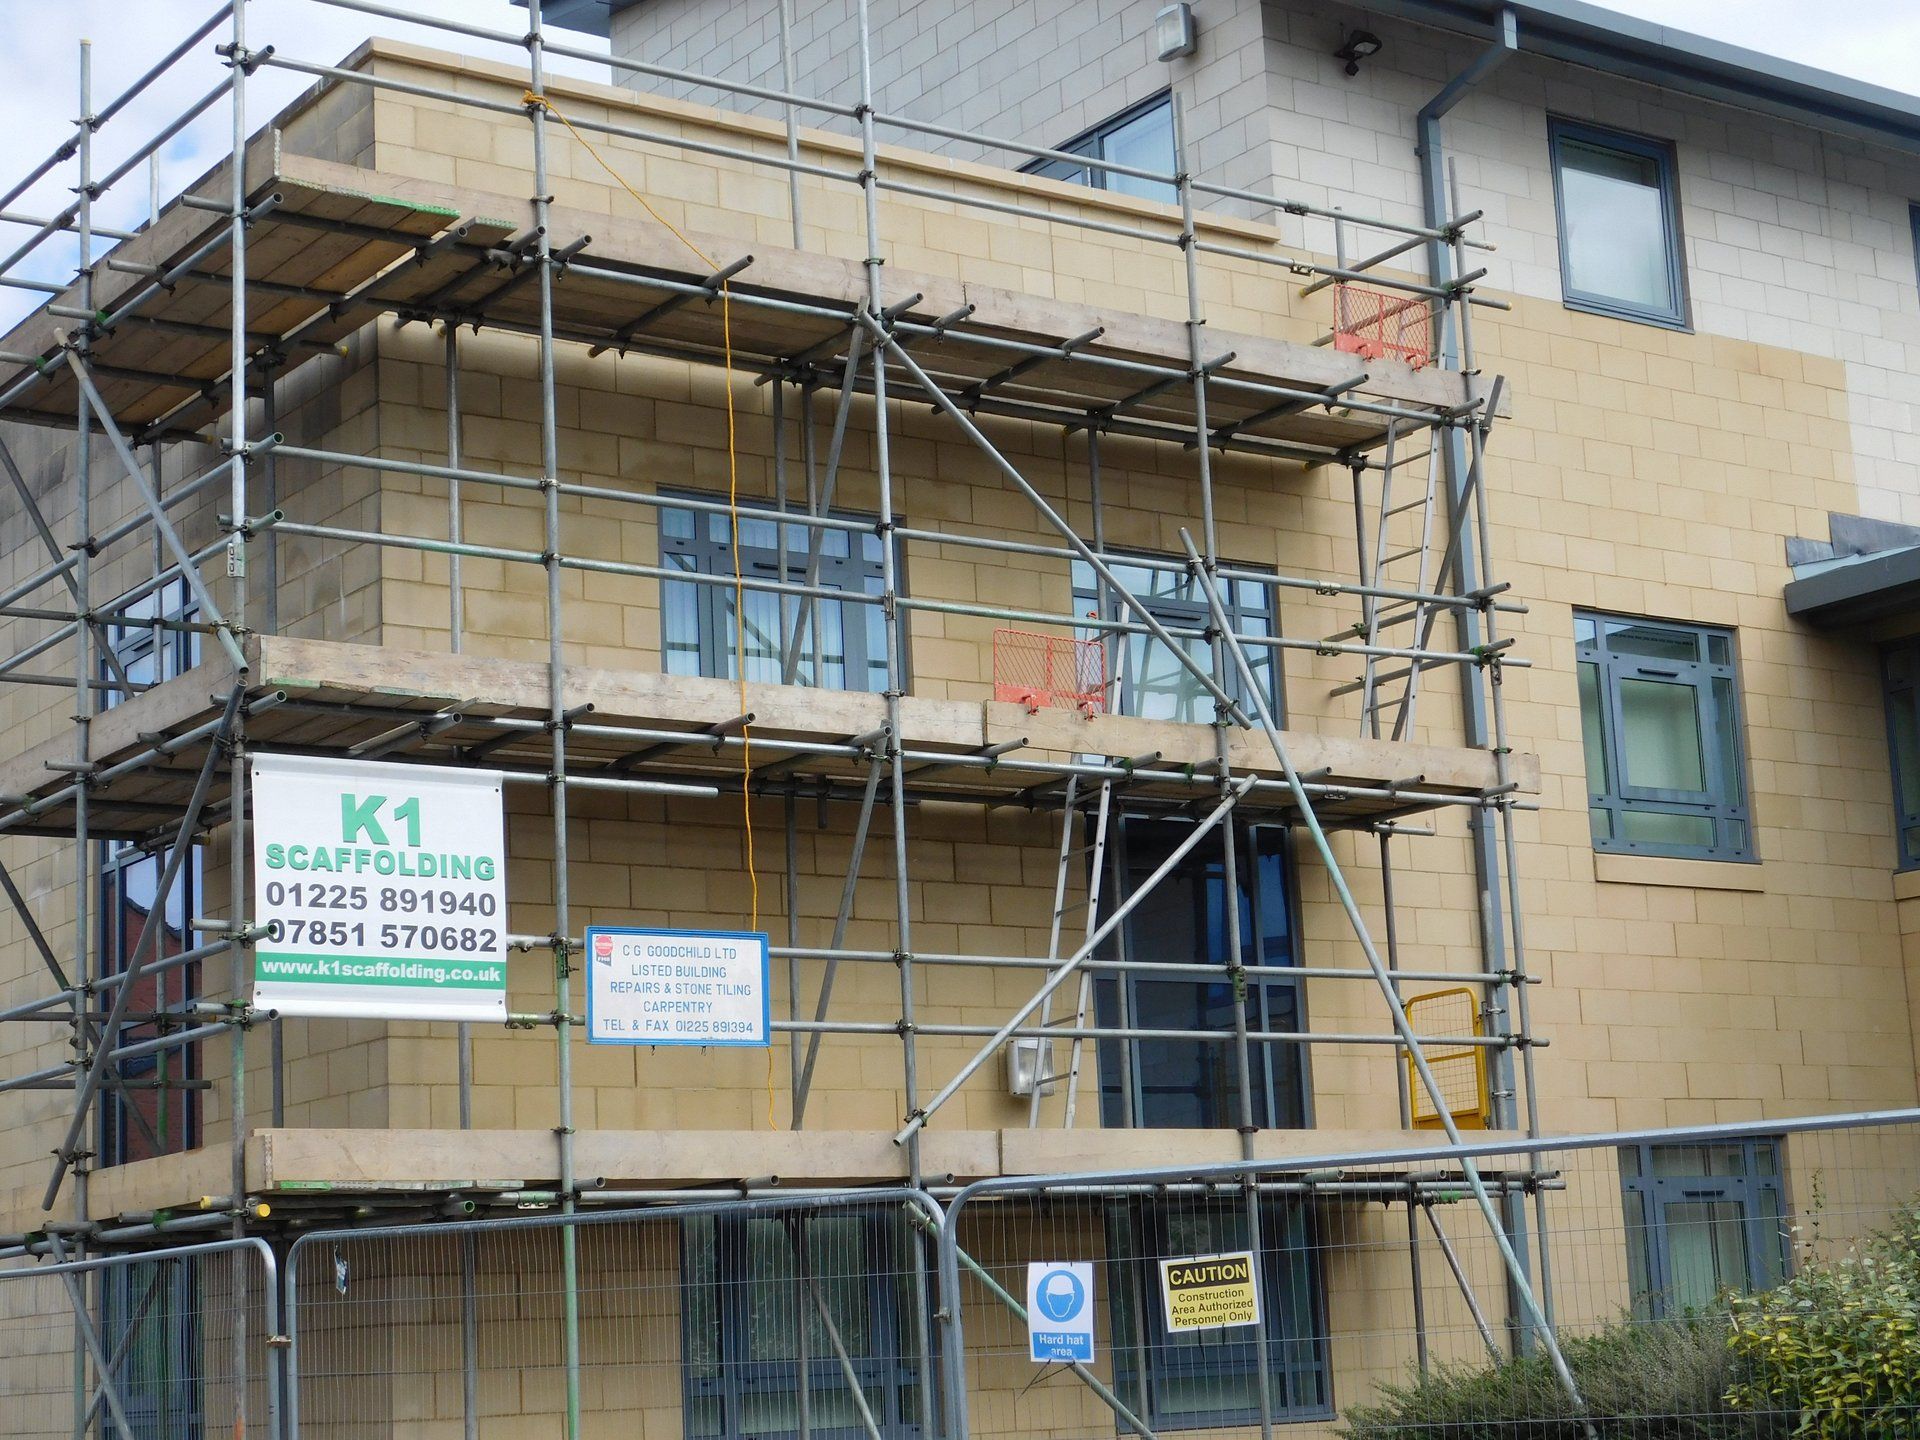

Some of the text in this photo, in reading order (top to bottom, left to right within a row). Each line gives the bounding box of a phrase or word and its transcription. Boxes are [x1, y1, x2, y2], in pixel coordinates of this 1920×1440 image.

[341, 793, 421, 847] K1
[265, 843, 495, 881] SCAFFOLDING
[266, 881, 496, 917] 01225 891940
[267, 918, 497, 952] 07851 570682
[647, 945, 711, 958] GOODCHILD
[715, 947, 737, 960] LTD
[262, 960, 501, 983] www.k1scaffolding.co.uk
[631, 964, 727, 978] LISTED BUILDING
[610, 981, 751, 996] REPAIRS & STONE TILING
[643, 1000, 713, 1013] CARPENTRY
[603, 1018, 753, 1033] TEL & FAX 01225 891394
[1169, 1263, 1247, 1285] CAUTION
[1178, 1289, 1244, 1303] Construction
[1171, 1298, 1253, 1315] Area Authorized
[1175, 1310, 1252, 1326] Personnel Only
[1039, 1334, 1084, 1345] Hard hat
[1050, 1347, 1073, 1357] area
